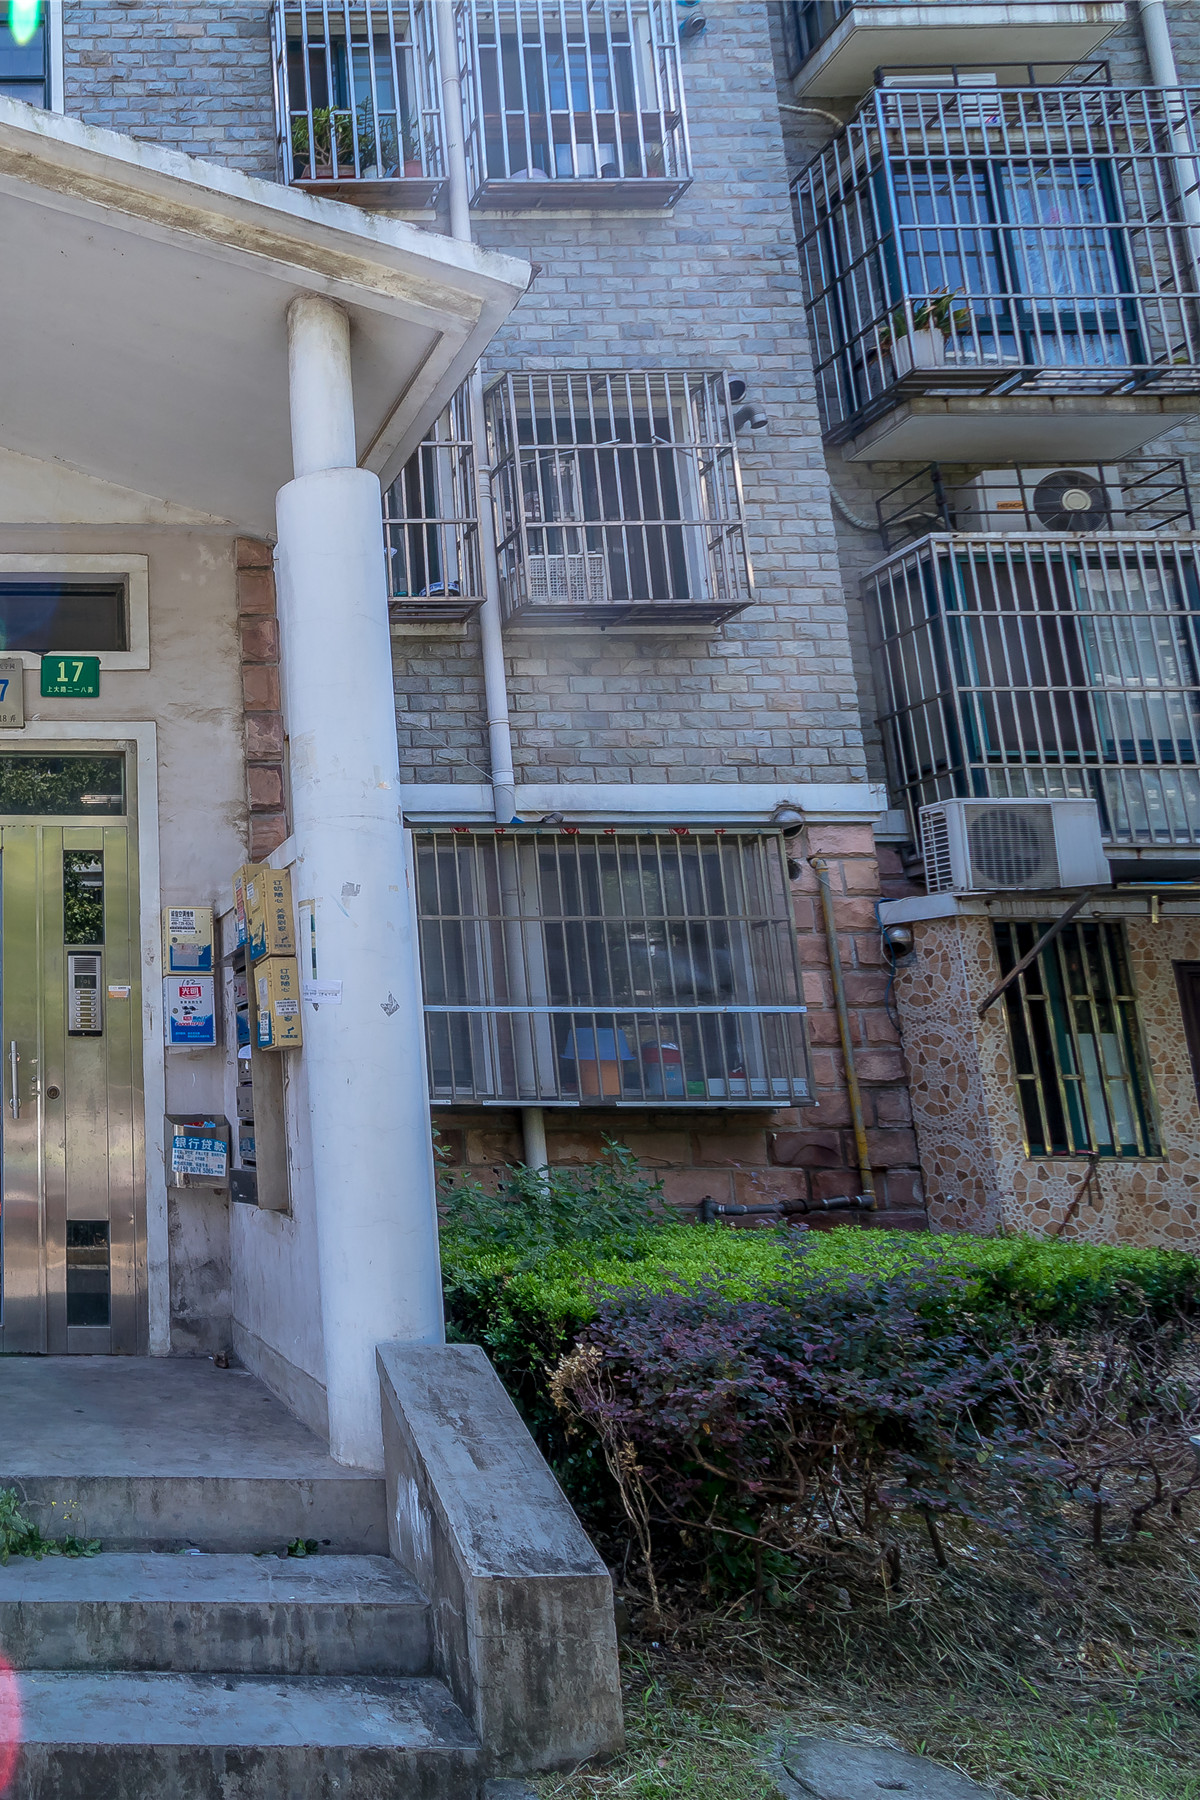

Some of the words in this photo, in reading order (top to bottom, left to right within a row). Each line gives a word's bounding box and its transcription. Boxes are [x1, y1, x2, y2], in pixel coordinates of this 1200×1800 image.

[56, 661, 84, 682] 17
[46, 685, 94, 694] 上大路二一八弄
[181, 986, 200, 995] 光明
[174, 1136, 225, 1153] 银行贷款
